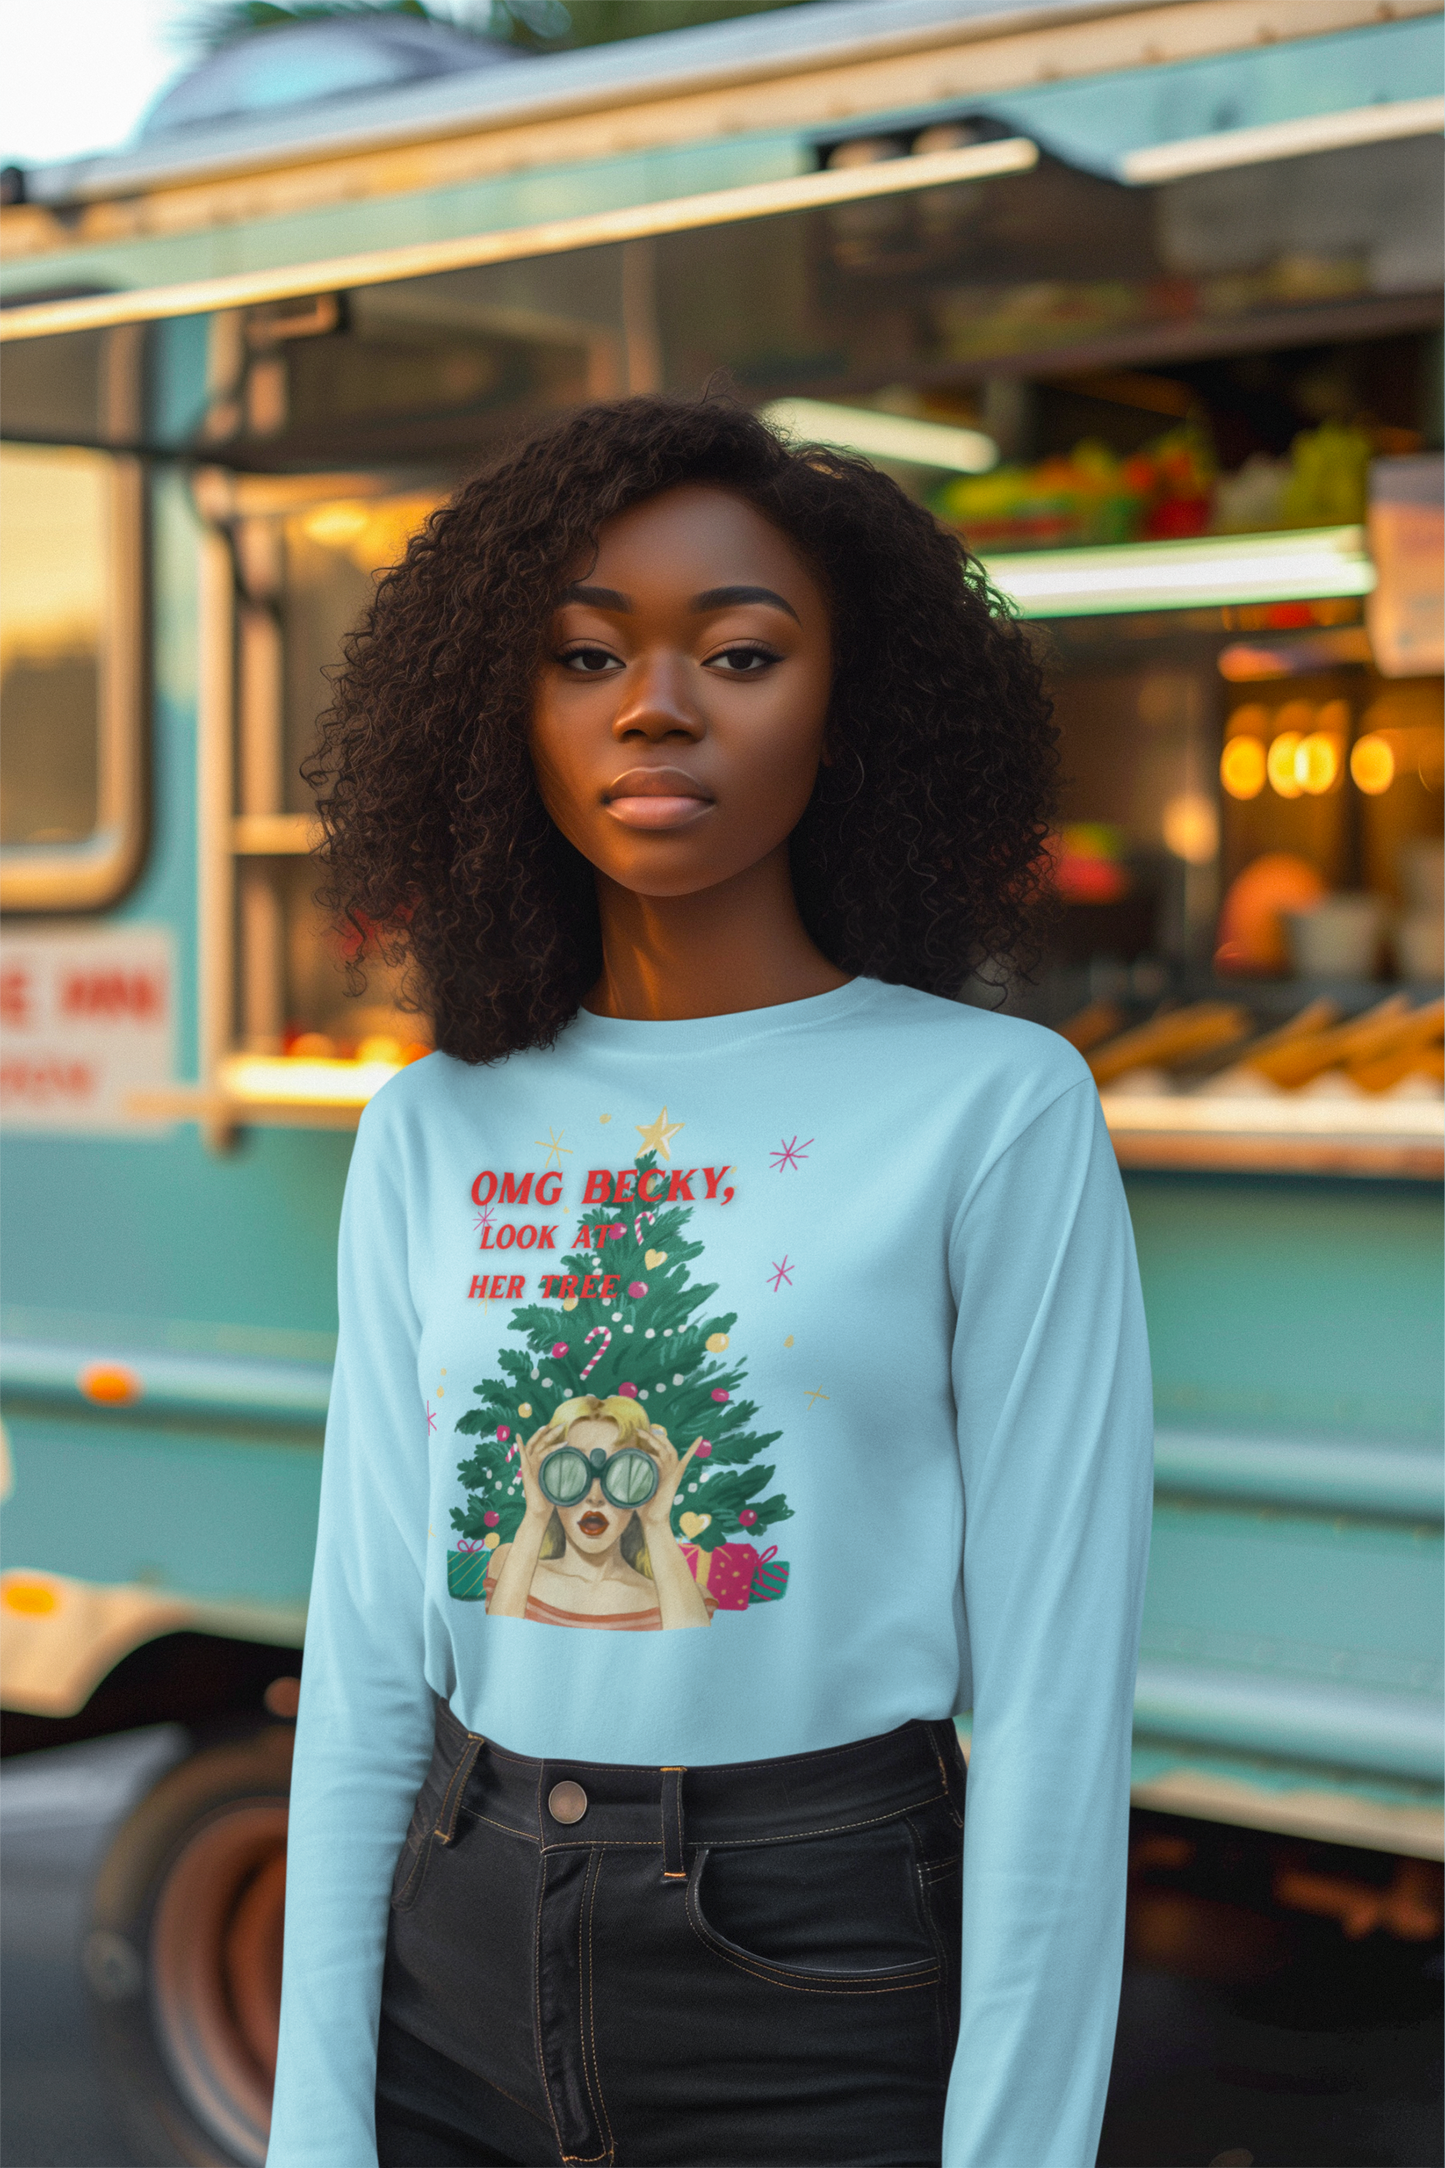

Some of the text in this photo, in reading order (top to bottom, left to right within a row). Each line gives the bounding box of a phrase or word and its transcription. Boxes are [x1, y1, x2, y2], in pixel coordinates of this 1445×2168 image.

[470, 1165, 735, 1206] OMG BECKY,
[479, 1224, 616, 1250] LOOK AT
[467, 1274, 621, 1299] HER TREE
